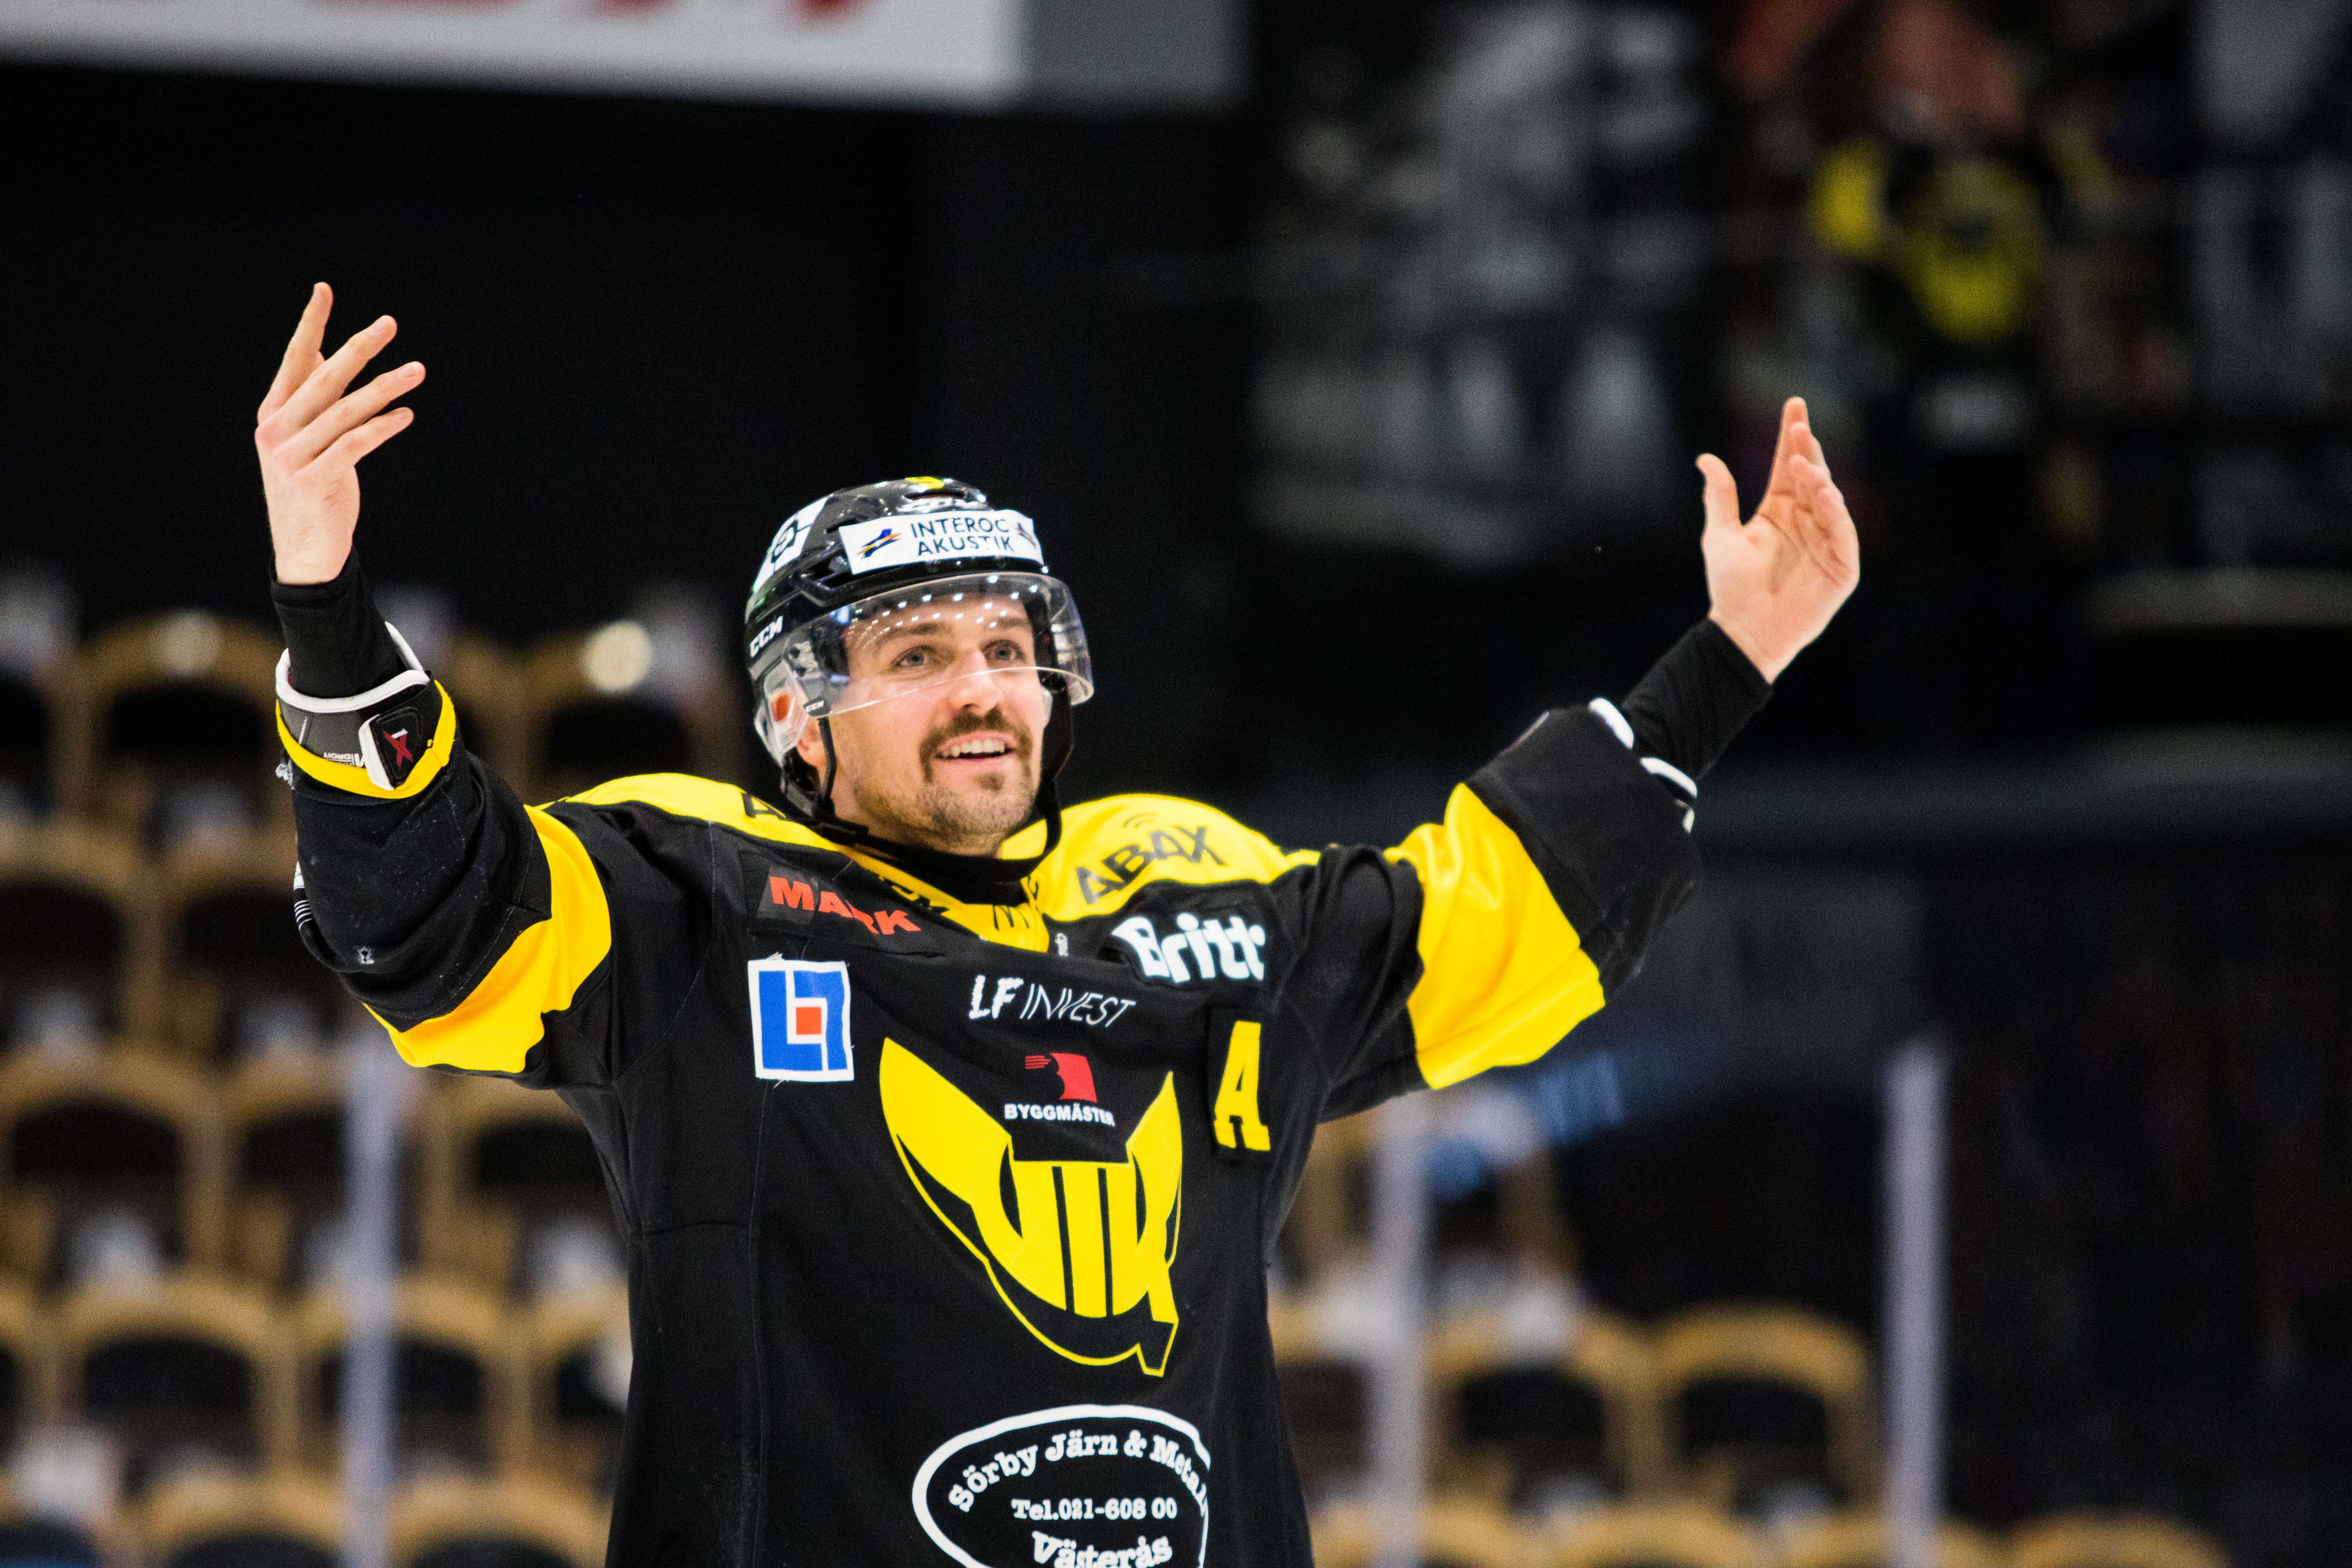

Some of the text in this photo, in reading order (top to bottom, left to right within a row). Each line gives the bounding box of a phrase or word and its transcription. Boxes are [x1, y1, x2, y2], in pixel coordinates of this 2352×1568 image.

[910, 517, 1009, 538] INTEROC
[918, 536, 1014, 556] AKUSTIK
[749, 615, 783, 658] CCM
[1076, 826, 1228, 904] ABAX
[969, 975, 1137, 1028] LF INVEST
[1214, 1020, 1271, 1152] A
[1004, 1102, 1115, 1127] BYGGMÄSTER
[948, 1444, 1038, 1512] Sörby
[1045, 1428, 1119, 1462] Järn
[1123, 1429, 1148, 1458] &
[1011, 1497, 1178, 1520] Tel.021-608 00
[1032, 1530, 1173, 1568] Västerås
